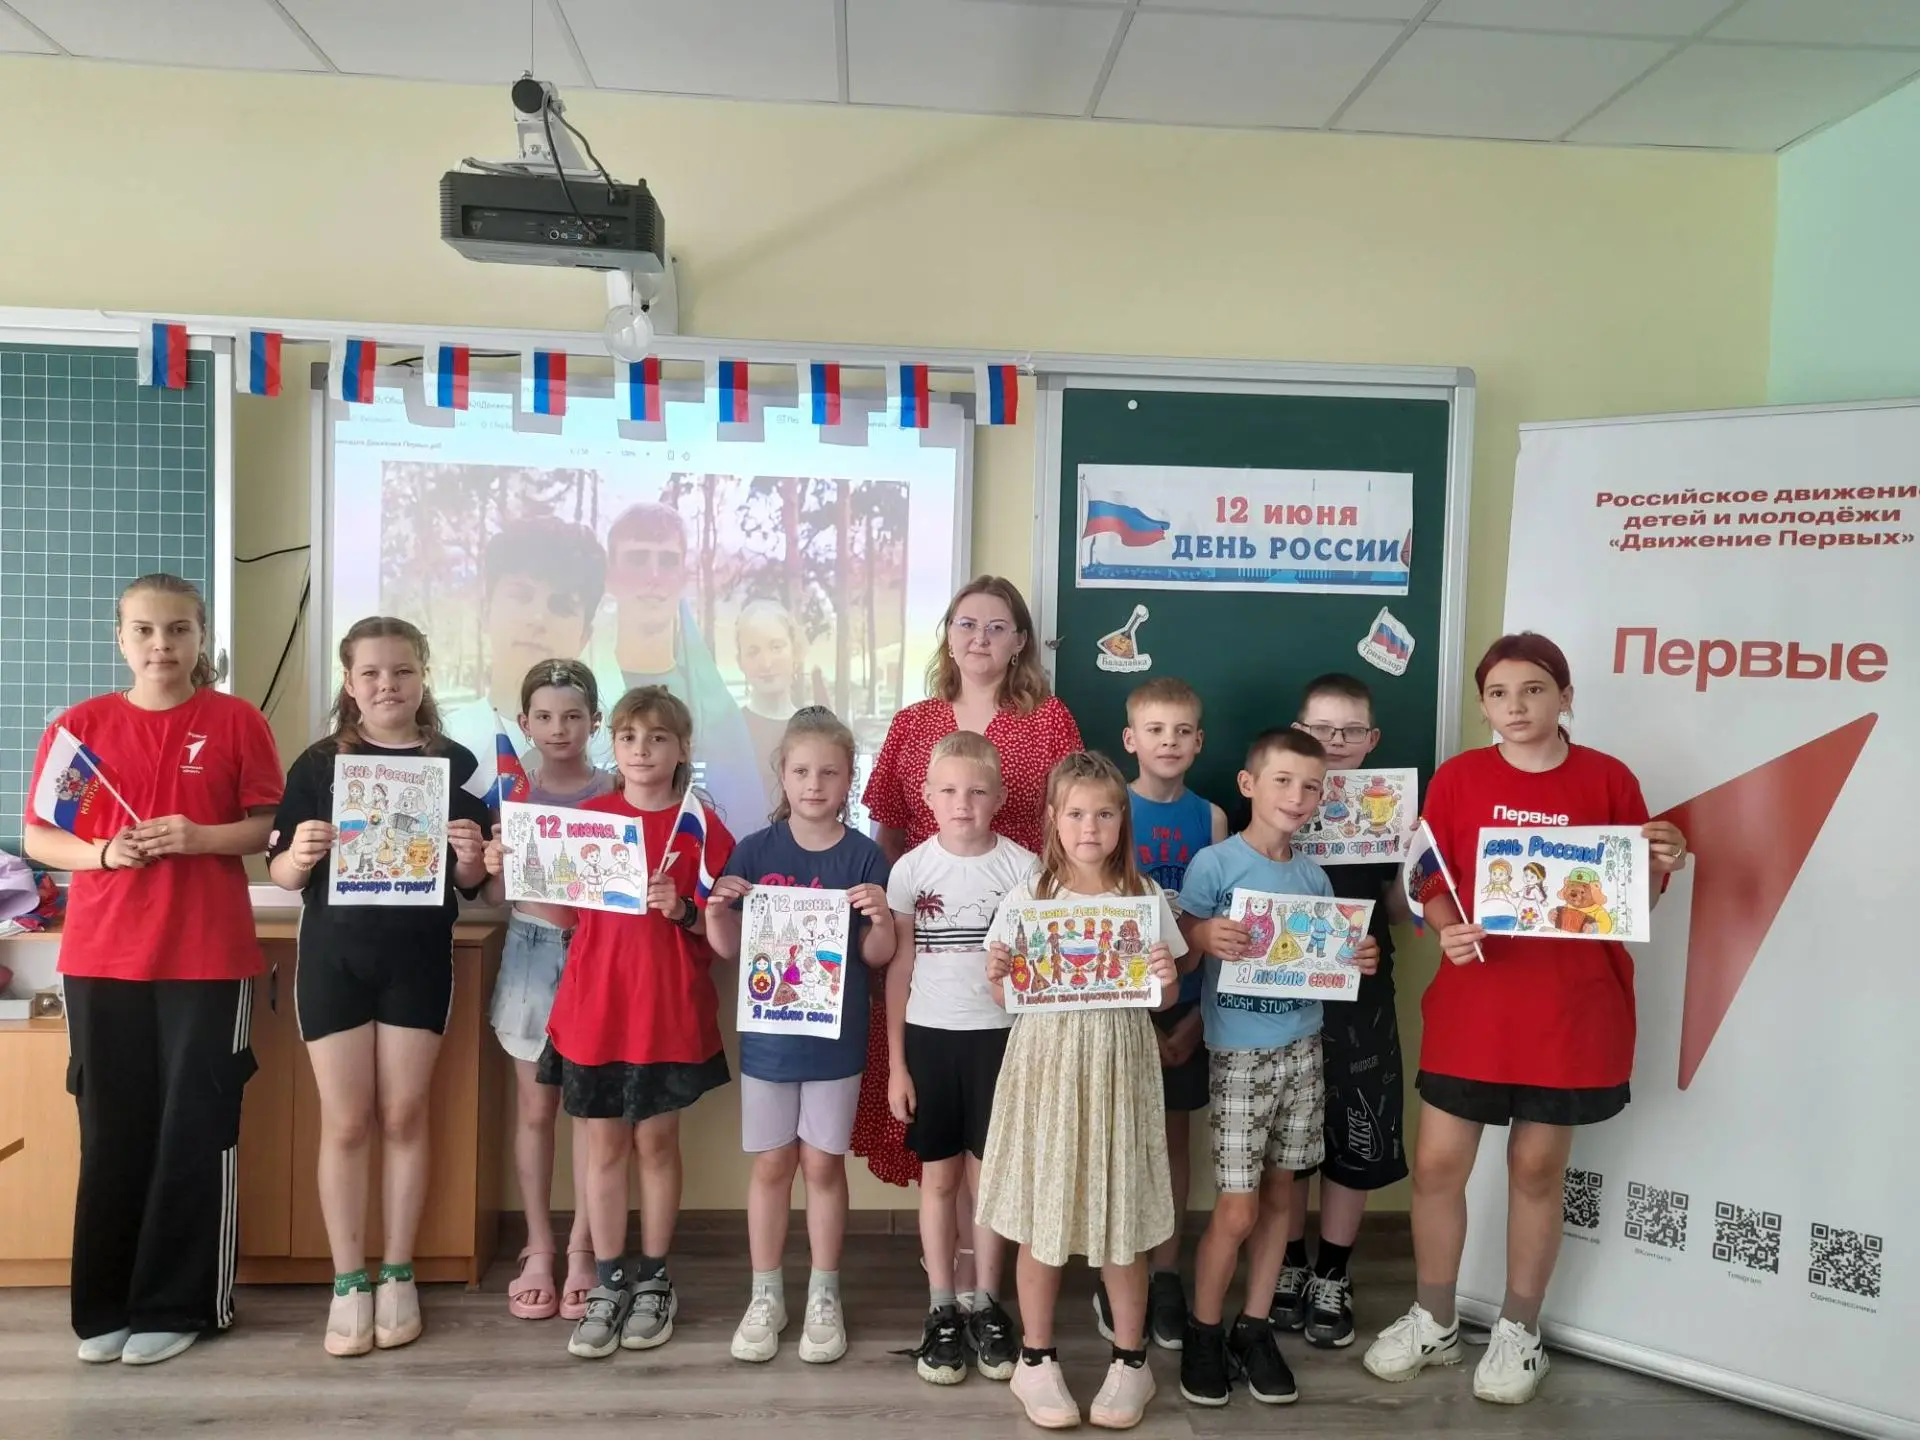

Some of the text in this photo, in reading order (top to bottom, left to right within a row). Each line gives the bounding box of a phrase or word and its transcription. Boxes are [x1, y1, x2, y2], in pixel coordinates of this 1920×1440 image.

[1596, 484, 1920, 507] Российское движени
[1216, 496, 1358, 526] 12 июня
[1623, 506, 1902, 529] детей и молодёжи
[1171, 534, 1401, 563] ДЕНЬ РОССИИ
[1609, 529, 1915, 552] «Движение Первых»
[1613, 626, 1889, 693] Первые
[343, 763, 427, 786] ень России!
[535, 814, 562, 839] 12
[1492, 804, 1570, 827] Первые
[1347, 834, 1400, 858] страну!
[1483, 835, 1605, 866] ень России!
[772, 894, 791, 913] 12
[1236, 963, 1252, 985] Я
[1252, 965, 1306, 987] люблю
[1308, 971, 1347, 990] свою
[752, 1004, 762, 1020] Я
[764, 1005, 805, 1023] люблю
[806, 1010, 834, 1024] свою
[1219, 993, 1255, 1012] CRUSH
[1259, 997, 1295, 1014] STUNT
[1347, 1106, 1372, 1158] NIKE
